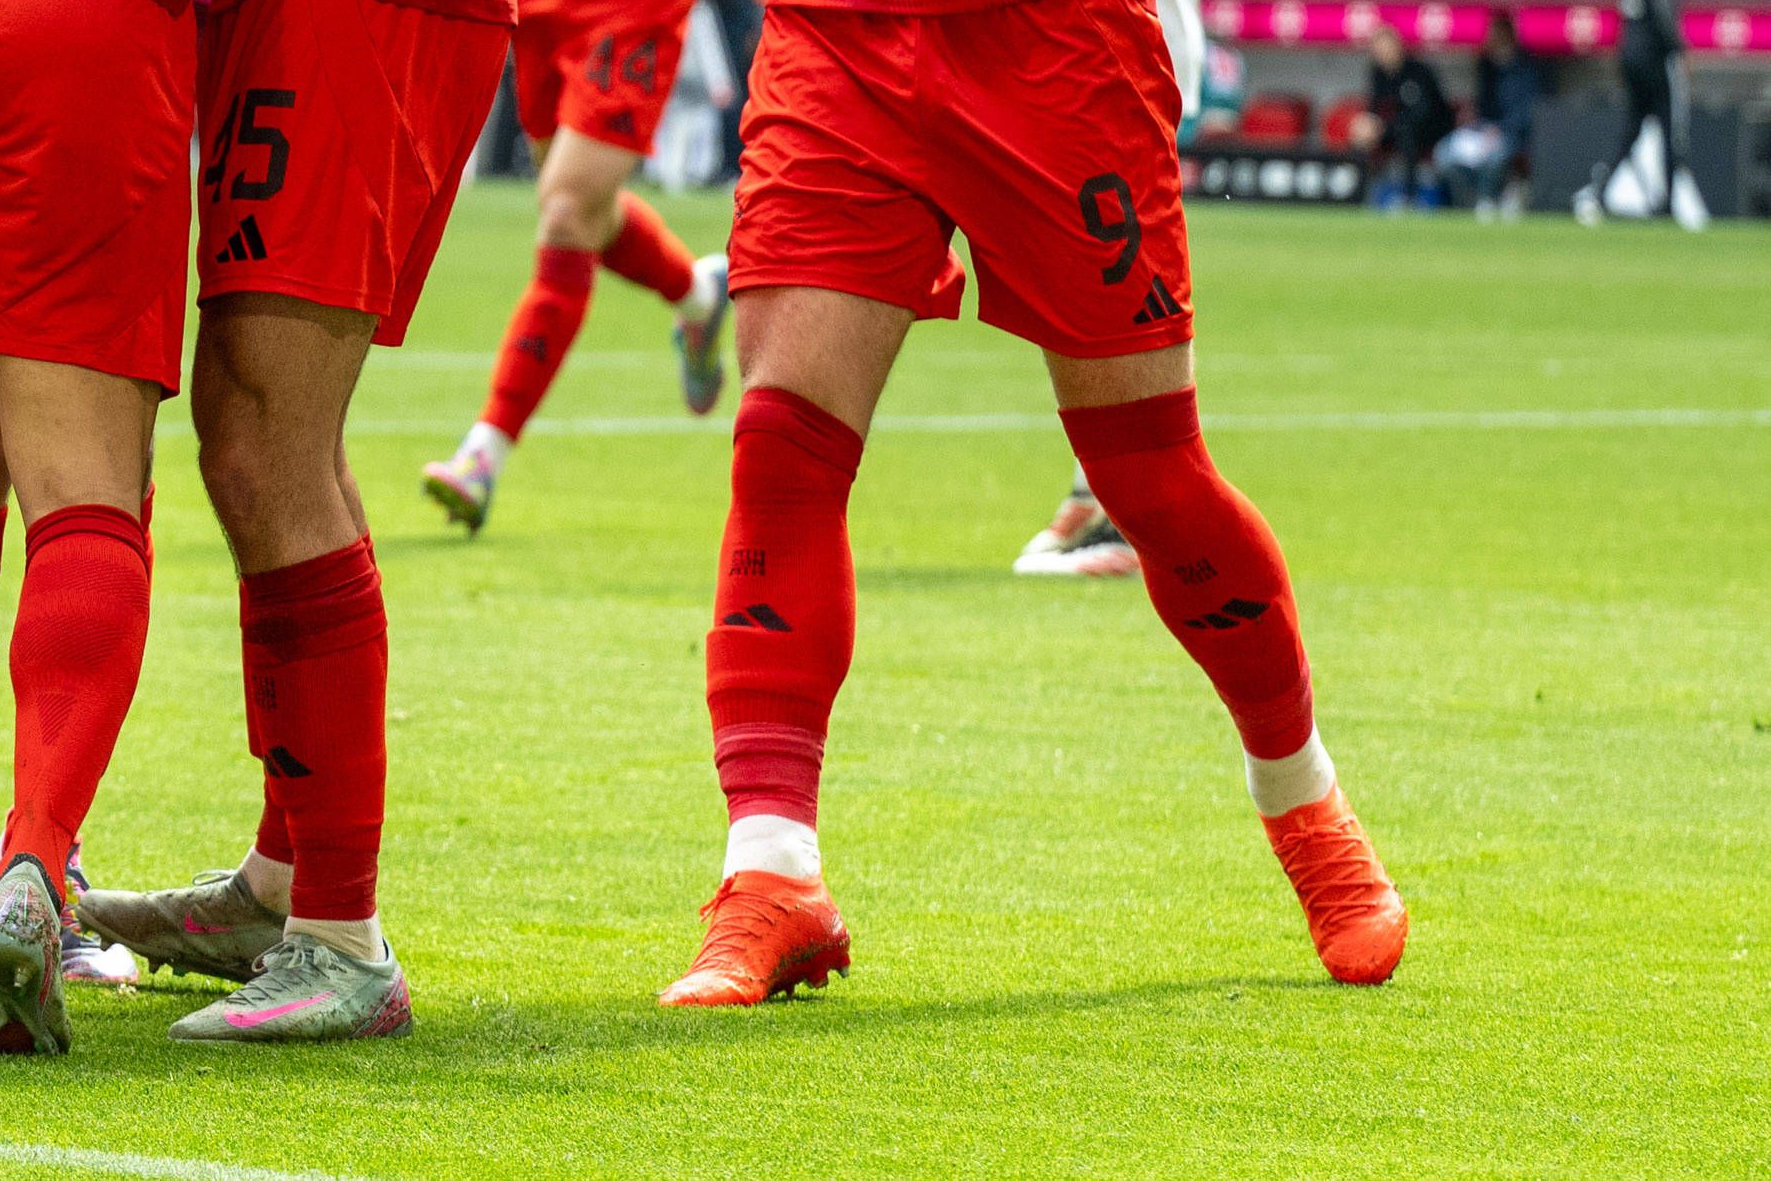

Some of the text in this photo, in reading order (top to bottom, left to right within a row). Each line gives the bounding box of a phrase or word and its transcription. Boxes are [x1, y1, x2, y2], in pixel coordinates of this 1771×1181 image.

[586, 35, 657, 94] 44
[204, 88, 296, 204] 45
[1077, 171, 1142, 286] 9
